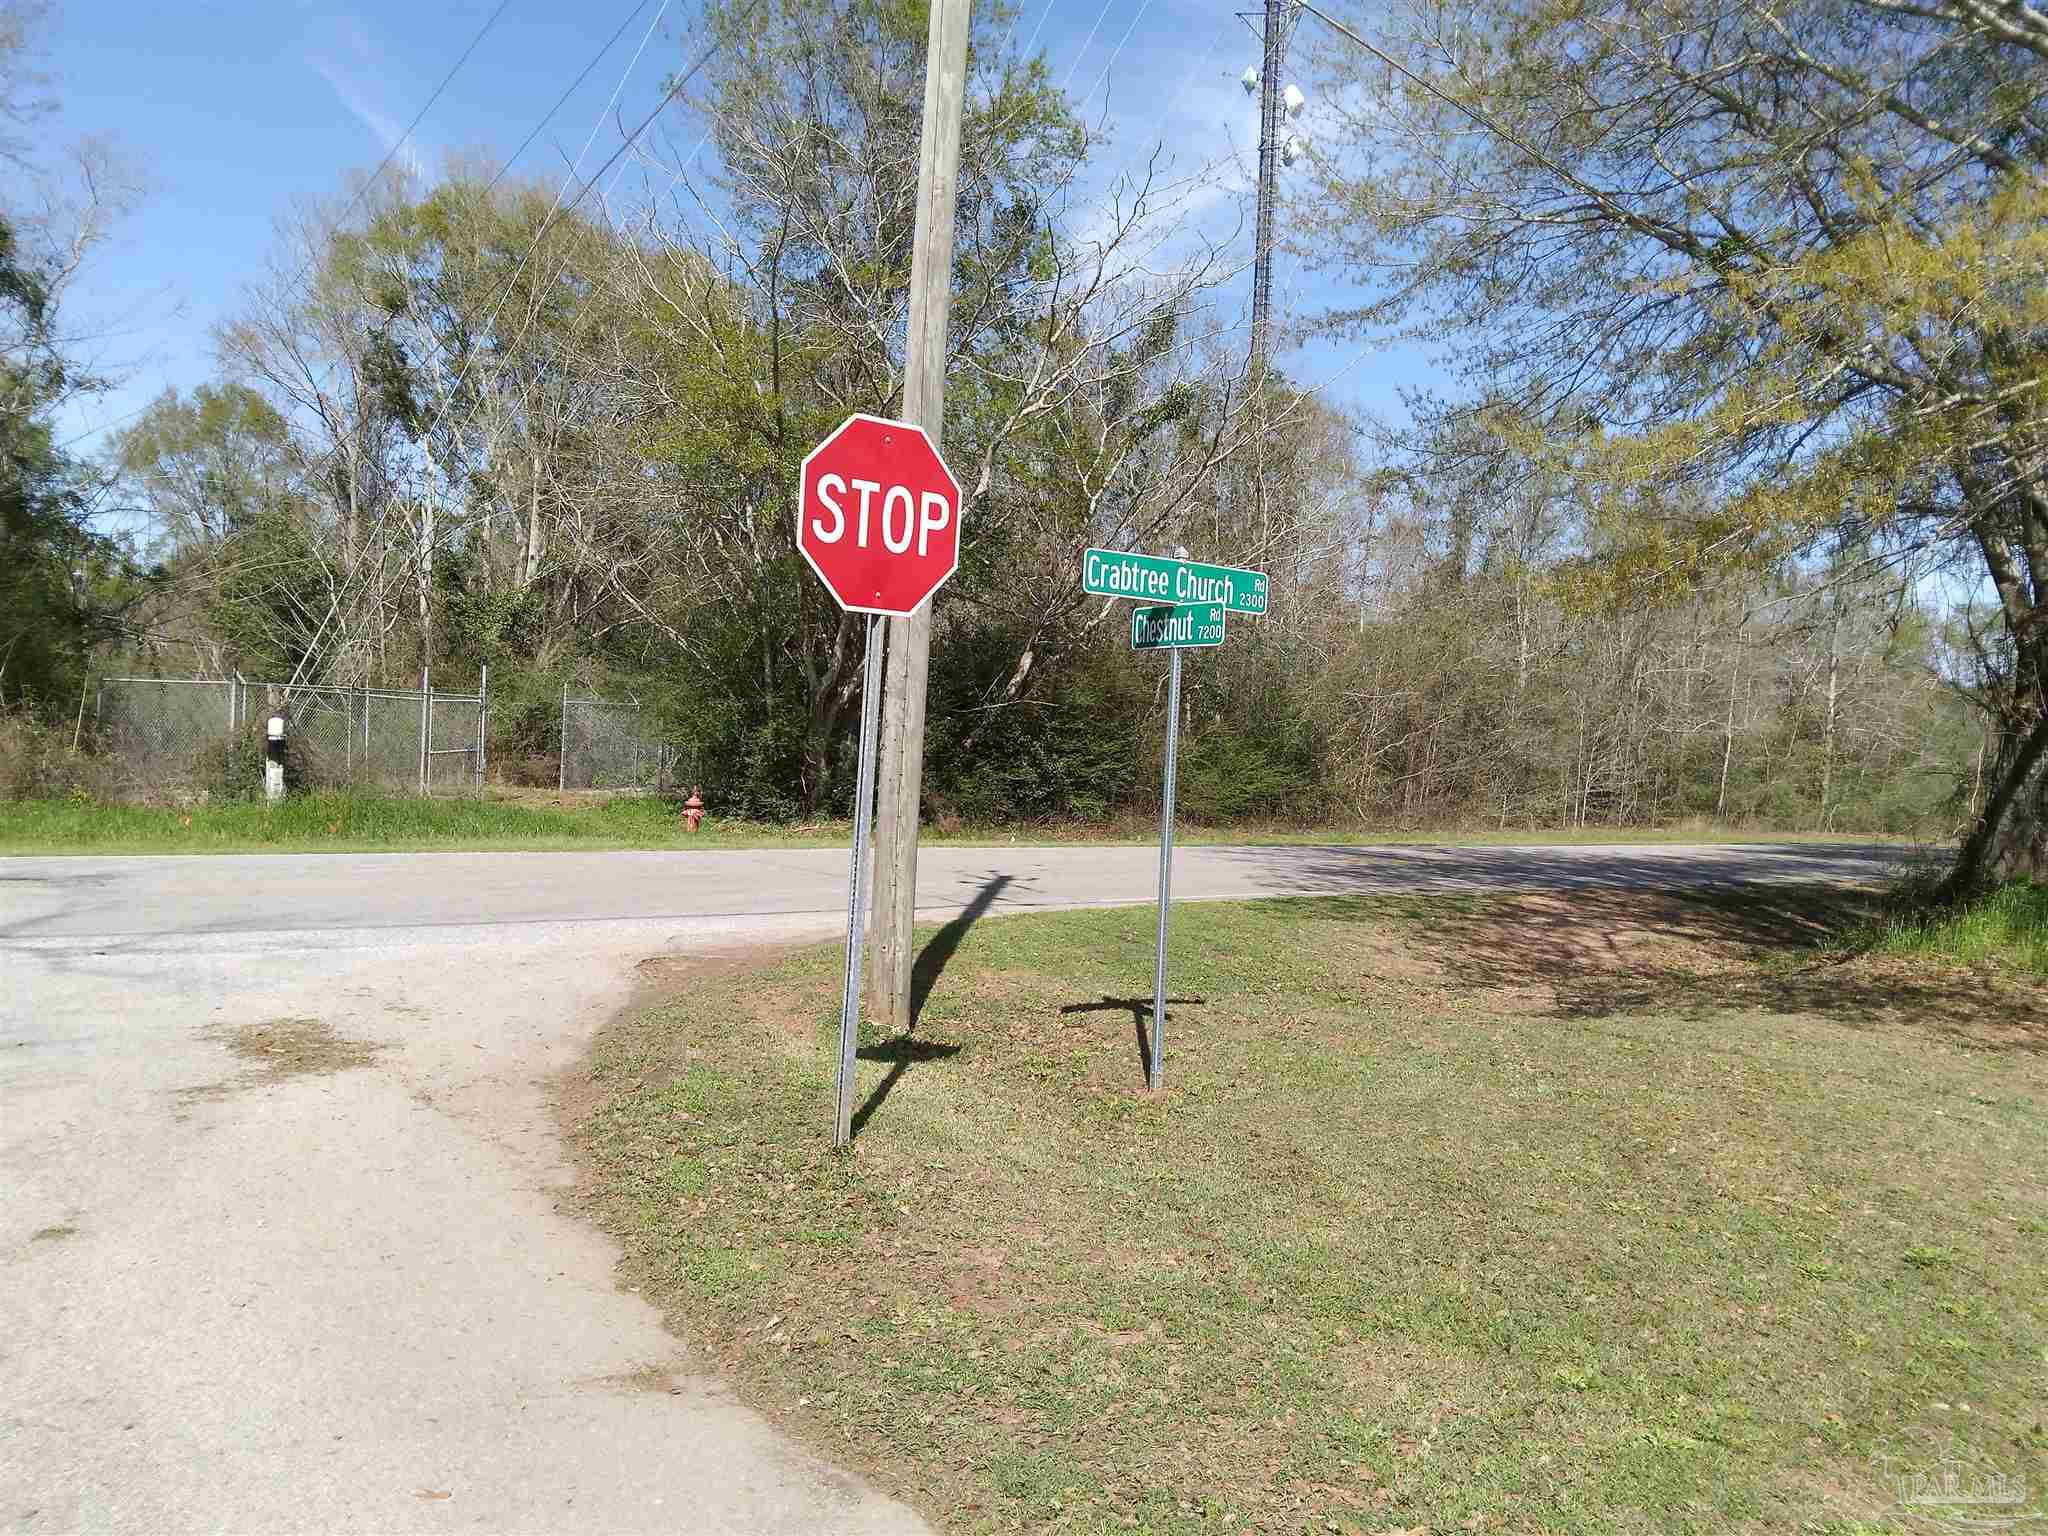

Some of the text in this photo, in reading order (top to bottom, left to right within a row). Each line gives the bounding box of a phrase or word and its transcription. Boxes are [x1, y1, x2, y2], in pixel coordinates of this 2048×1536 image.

[812, 472, 950, 557] STOP
[1088, 555, 1234, 606] Crabtree Church
[1254, 578, 1265, 592] Rd
[1239, 592, 1265, 608] 2300
[1209, 607, 1221, 622] Rd
[1135, 609, 1194, 643] Chestnut
[1198, 624, 1222, 640] 7200
